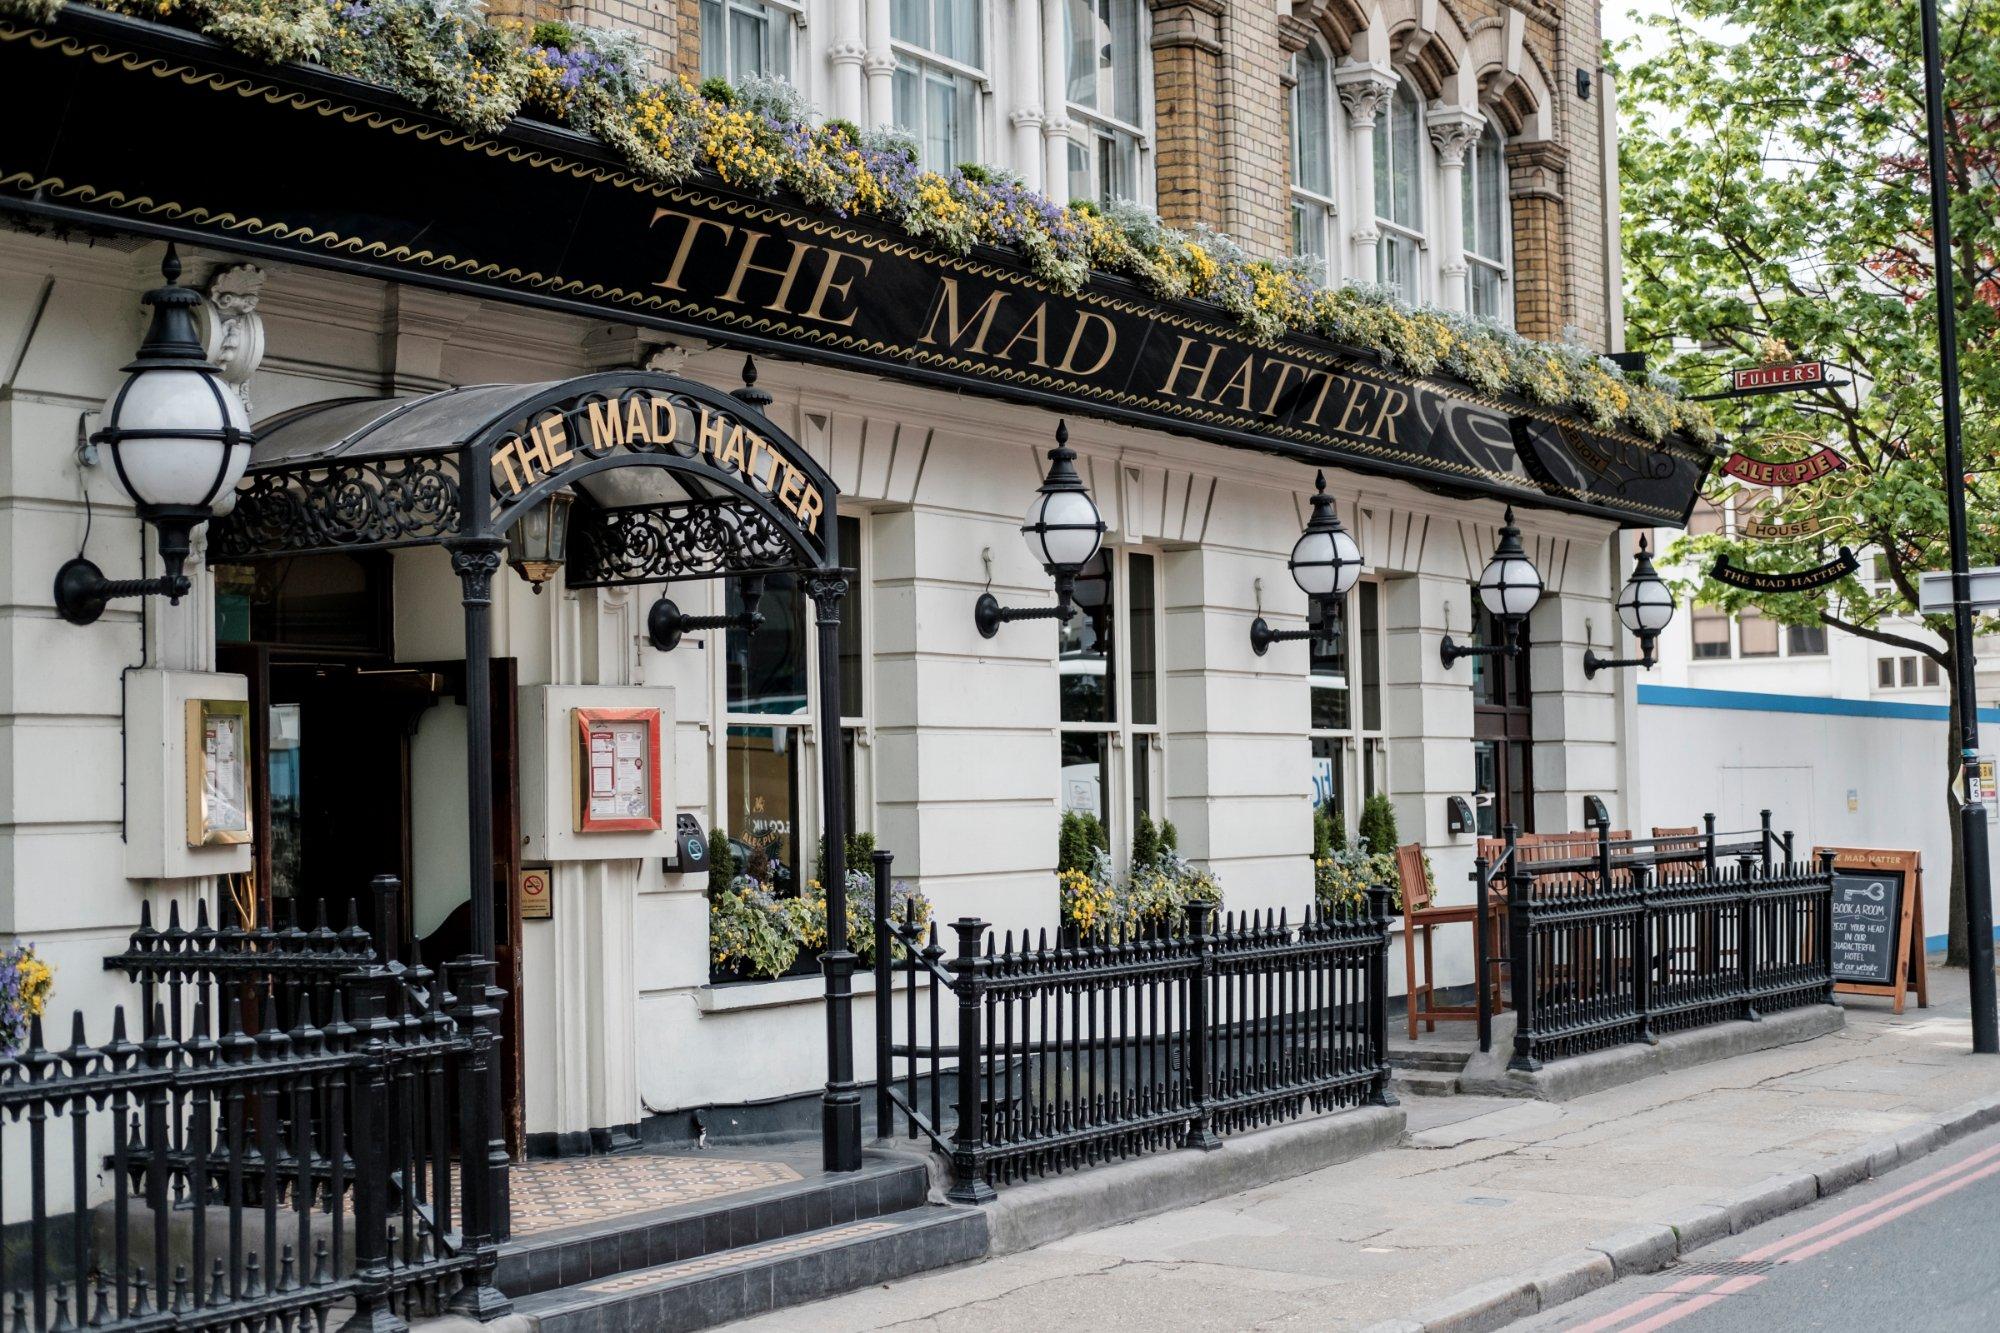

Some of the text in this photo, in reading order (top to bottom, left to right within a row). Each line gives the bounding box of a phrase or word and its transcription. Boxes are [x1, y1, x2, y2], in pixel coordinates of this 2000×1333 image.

[649, 207, 1408, 444] THE MAD HATTER
[1739, 366, 1816, 387] FULLER'S
[490, 397, 824, 535] THE MAD HATTER
[1734, 455, 1831, 484] ALE & PIE
[1755, 521, 1811, 537] HOUSE
[1723, 562, 1847, 588] THE MAD HATTER
[1844, 854, 1866, 863] MAD
[1868, 855, 1902, 864] HATTER
[1832, 902, 1885, 916] BOOK A ROOM
[1850, 924, 1866, 932] YOUR
[1867, 924, 1885, 933] HEAD
[1844, 933, 1867, 942] IN OUR
[1844, 952, 1865, 961] HOTEL
